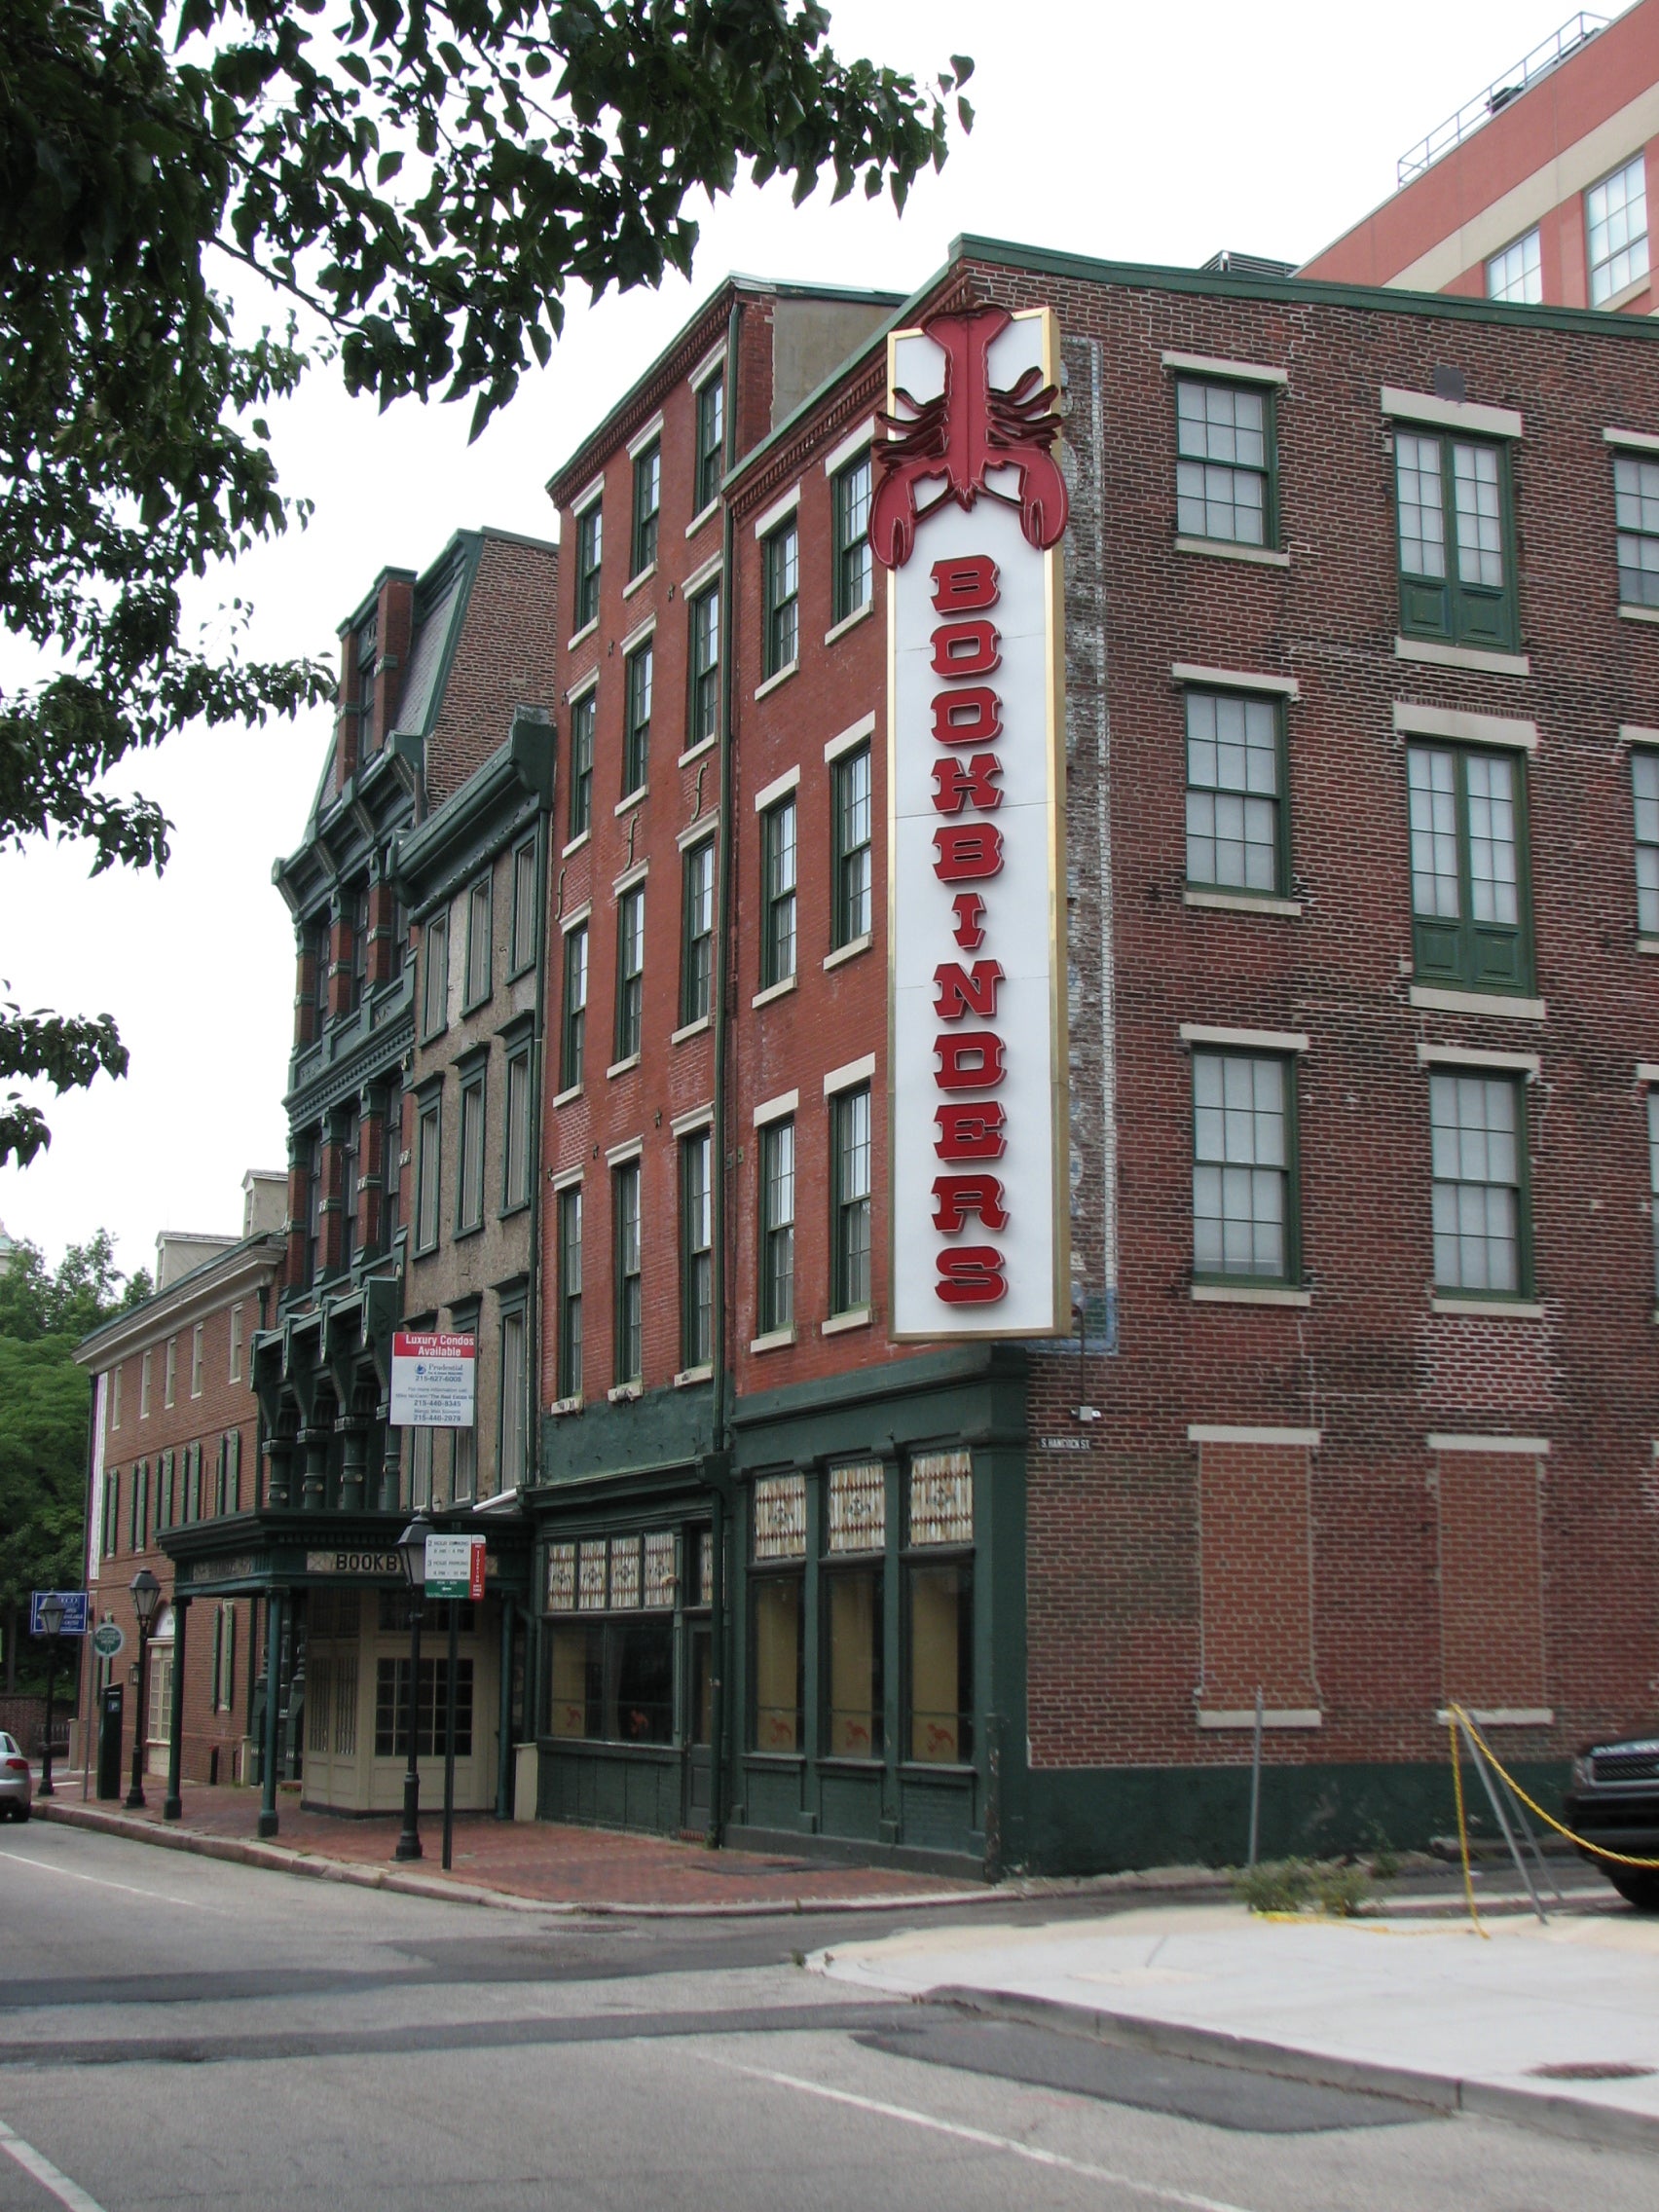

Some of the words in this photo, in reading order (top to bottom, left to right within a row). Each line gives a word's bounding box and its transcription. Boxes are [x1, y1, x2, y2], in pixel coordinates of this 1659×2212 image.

[929, 553, 1010, 1305] BOOKBINDERS
[405, 1334, 437, 1346] Luxury
[440, 1335, 474, 1346] Condos
[418, 1346, 461, 1356] Available
